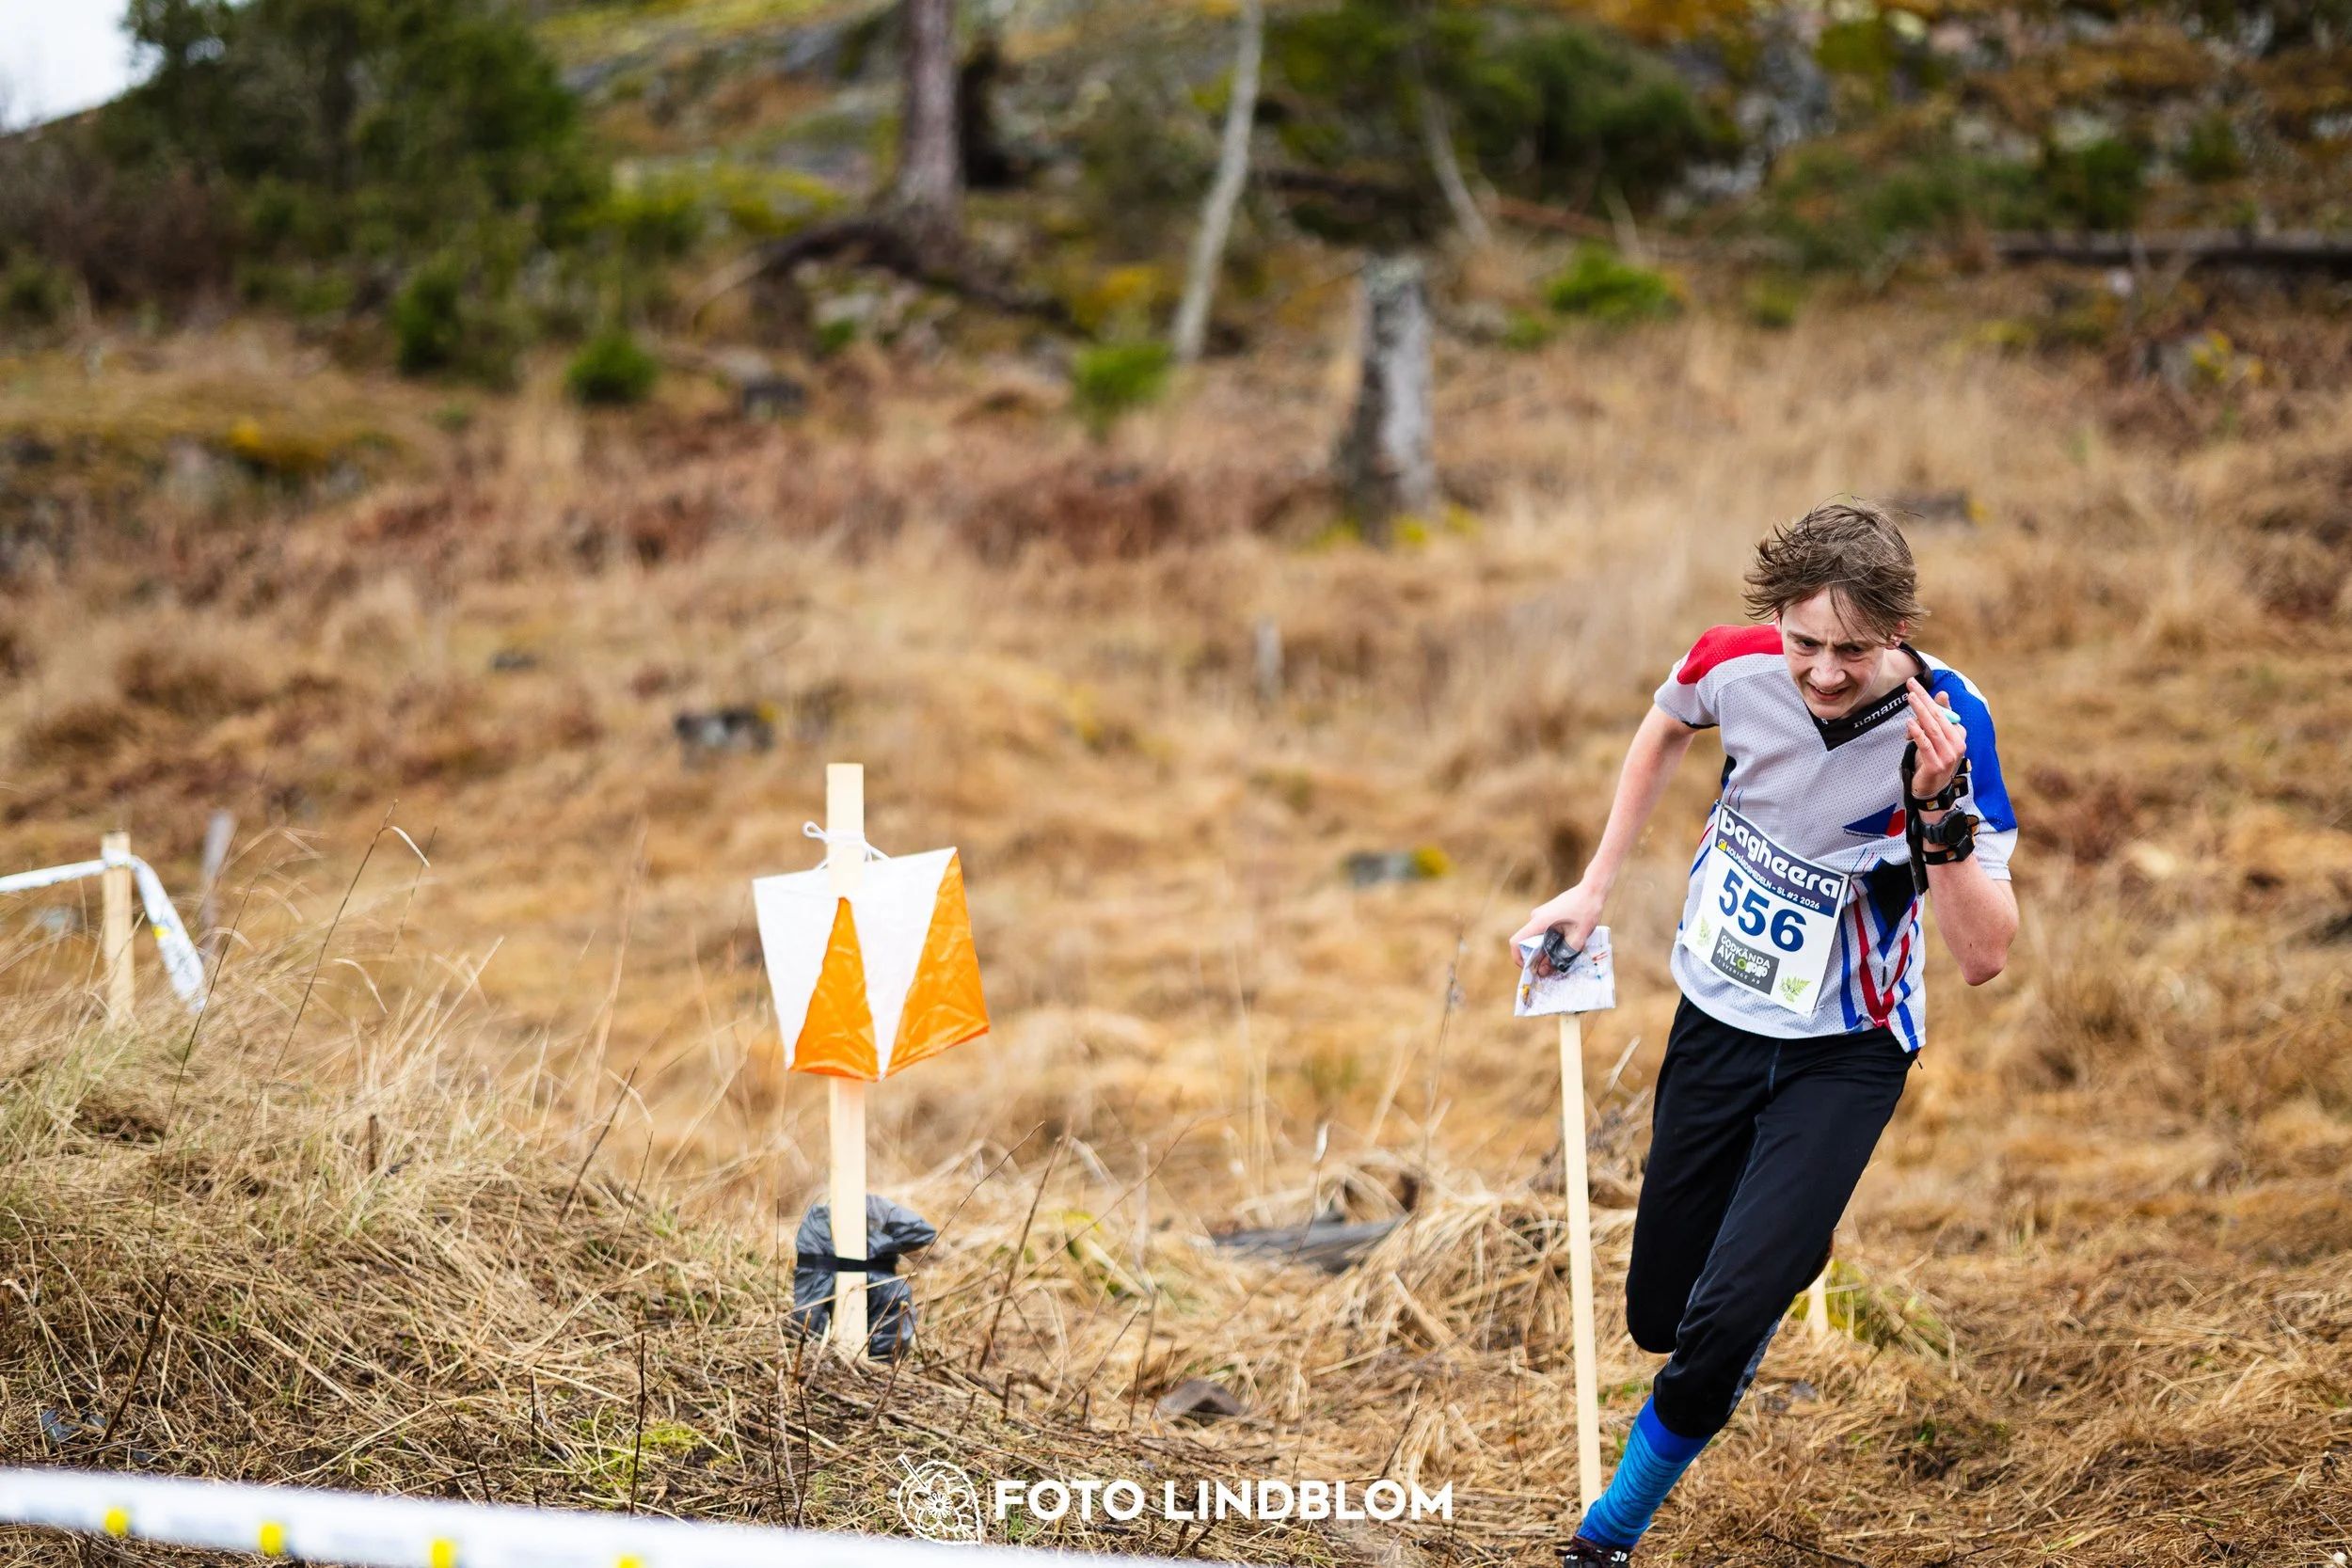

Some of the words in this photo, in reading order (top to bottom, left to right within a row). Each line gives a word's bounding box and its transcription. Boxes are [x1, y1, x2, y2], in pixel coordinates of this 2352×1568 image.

[1853, 692, 1909, 729] noname
[1719, 810, 1841, 899] bagheera
[1718, 868, 1807, 953] 556
[1777, 886, 1787, 897] SL
[1787, 892, 1799, 901] #2
[1799, 896, 1820, 910] 2026
[1721, 935, 1771, 969] GODKÄNDA
